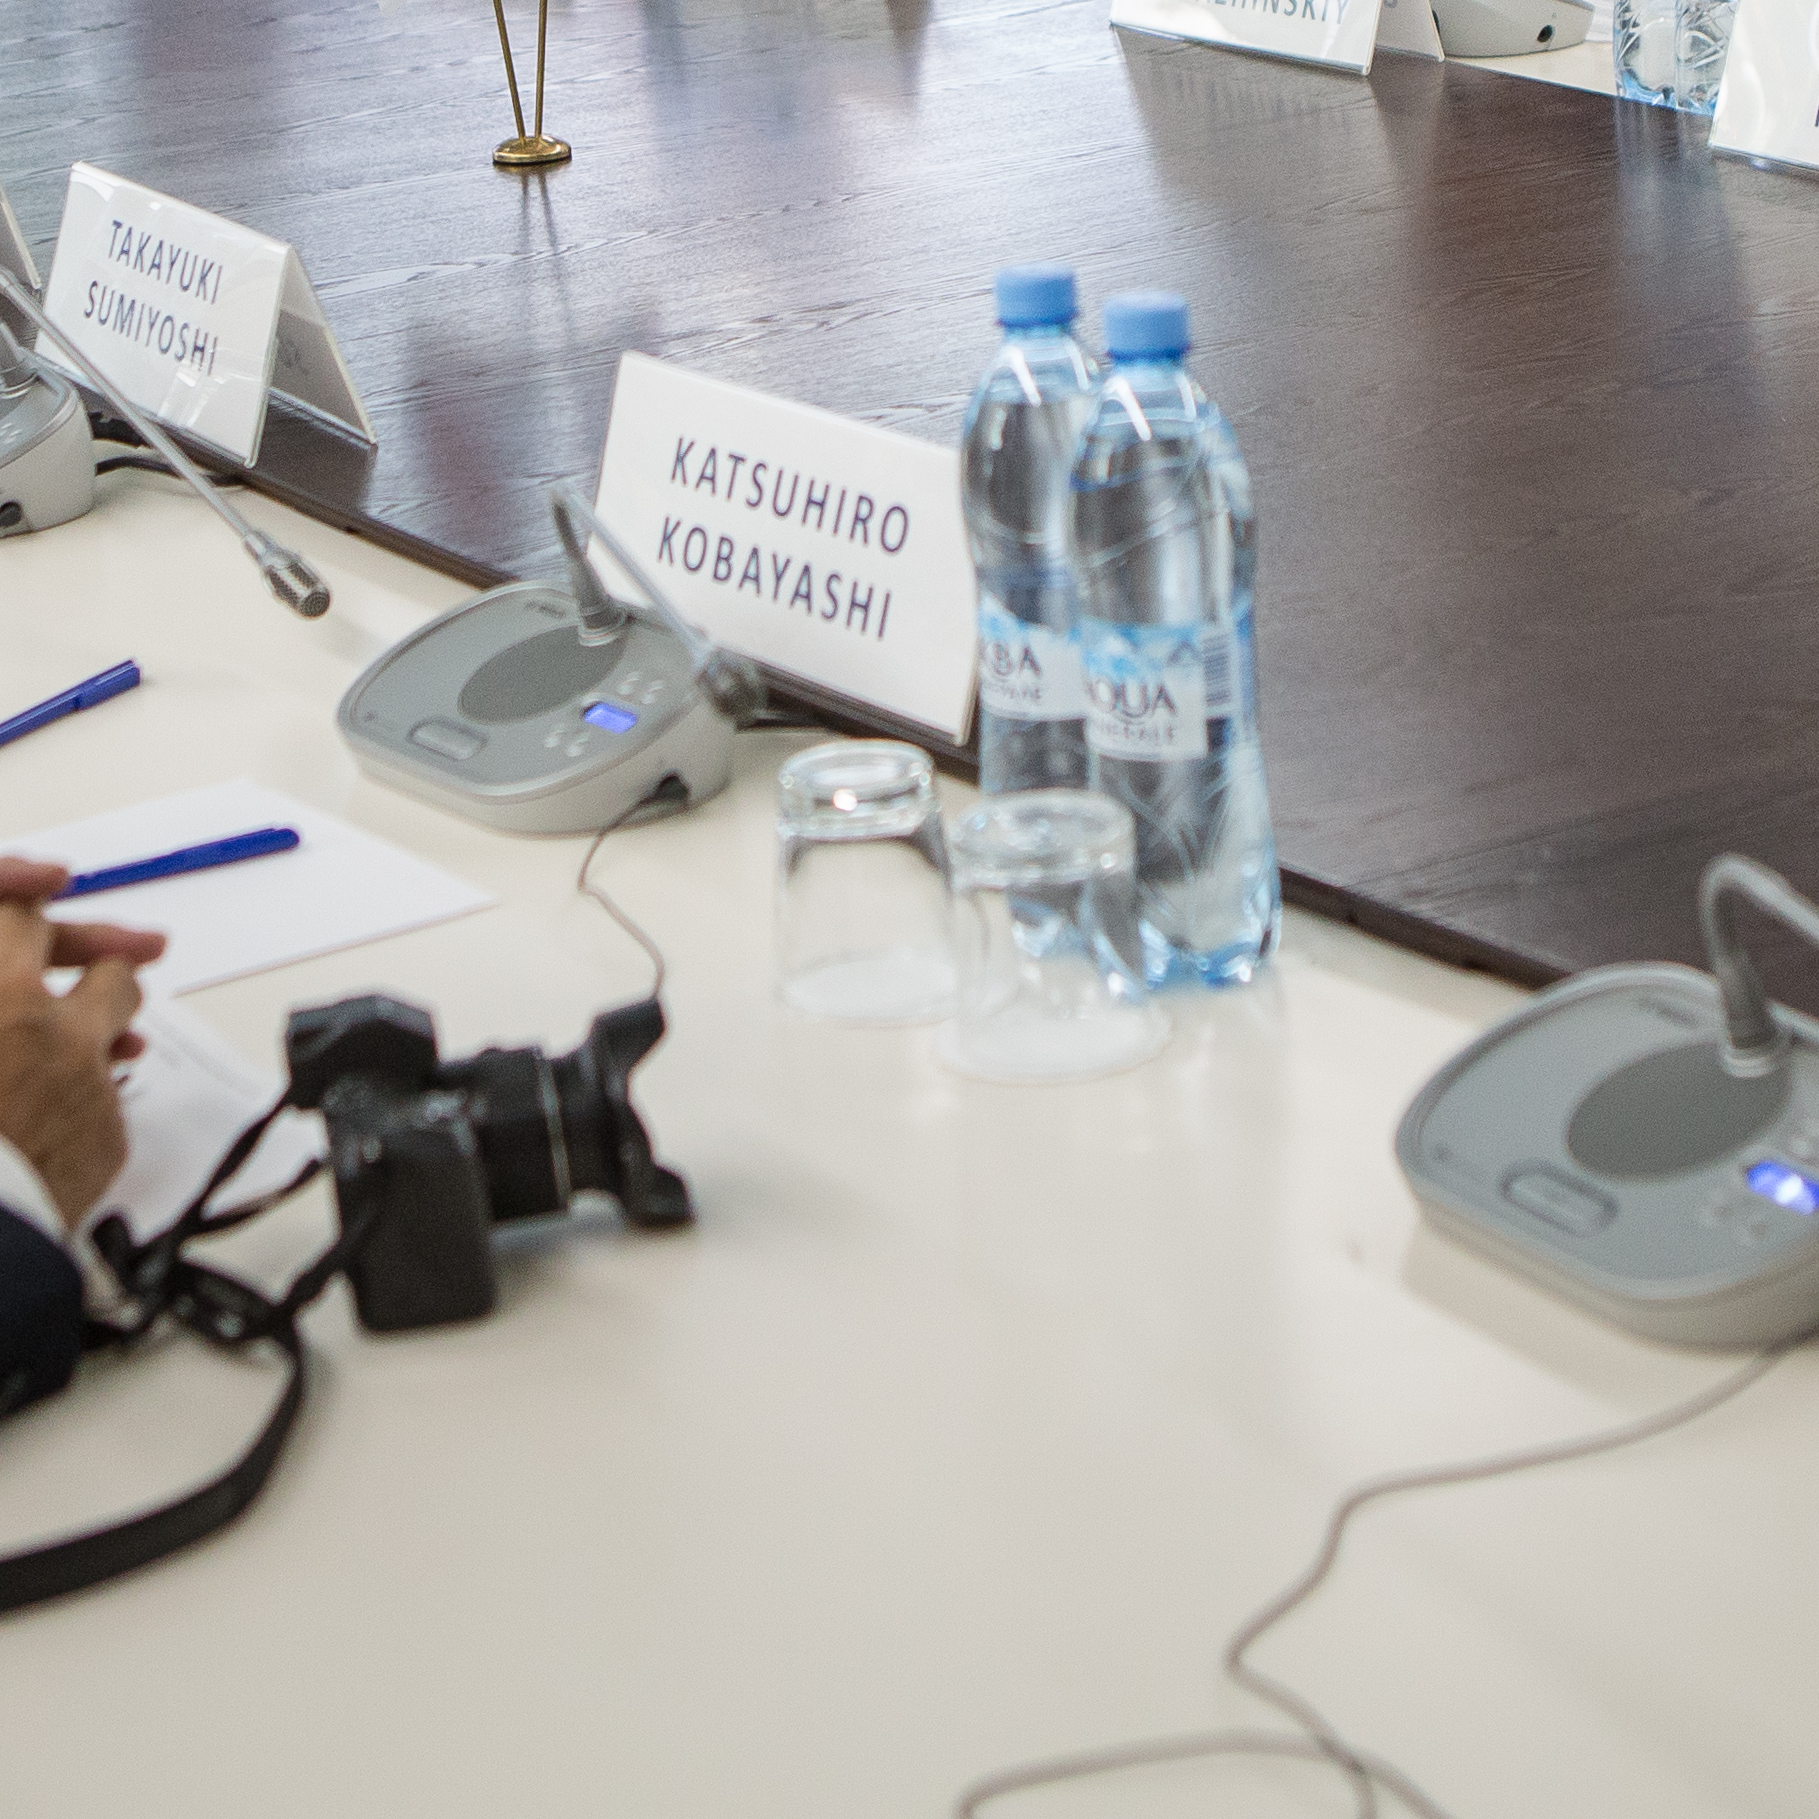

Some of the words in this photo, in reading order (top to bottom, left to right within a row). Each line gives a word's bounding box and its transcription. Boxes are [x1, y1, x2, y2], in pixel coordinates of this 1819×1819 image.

[109, 219, 223, 305] TAKAYUKI
[84, 280, 219, 377] SUMIYOSHI
[670, 436, 910, 554] KATSUHIRO
[657, 515, 892, 640] KOBAYASHI
